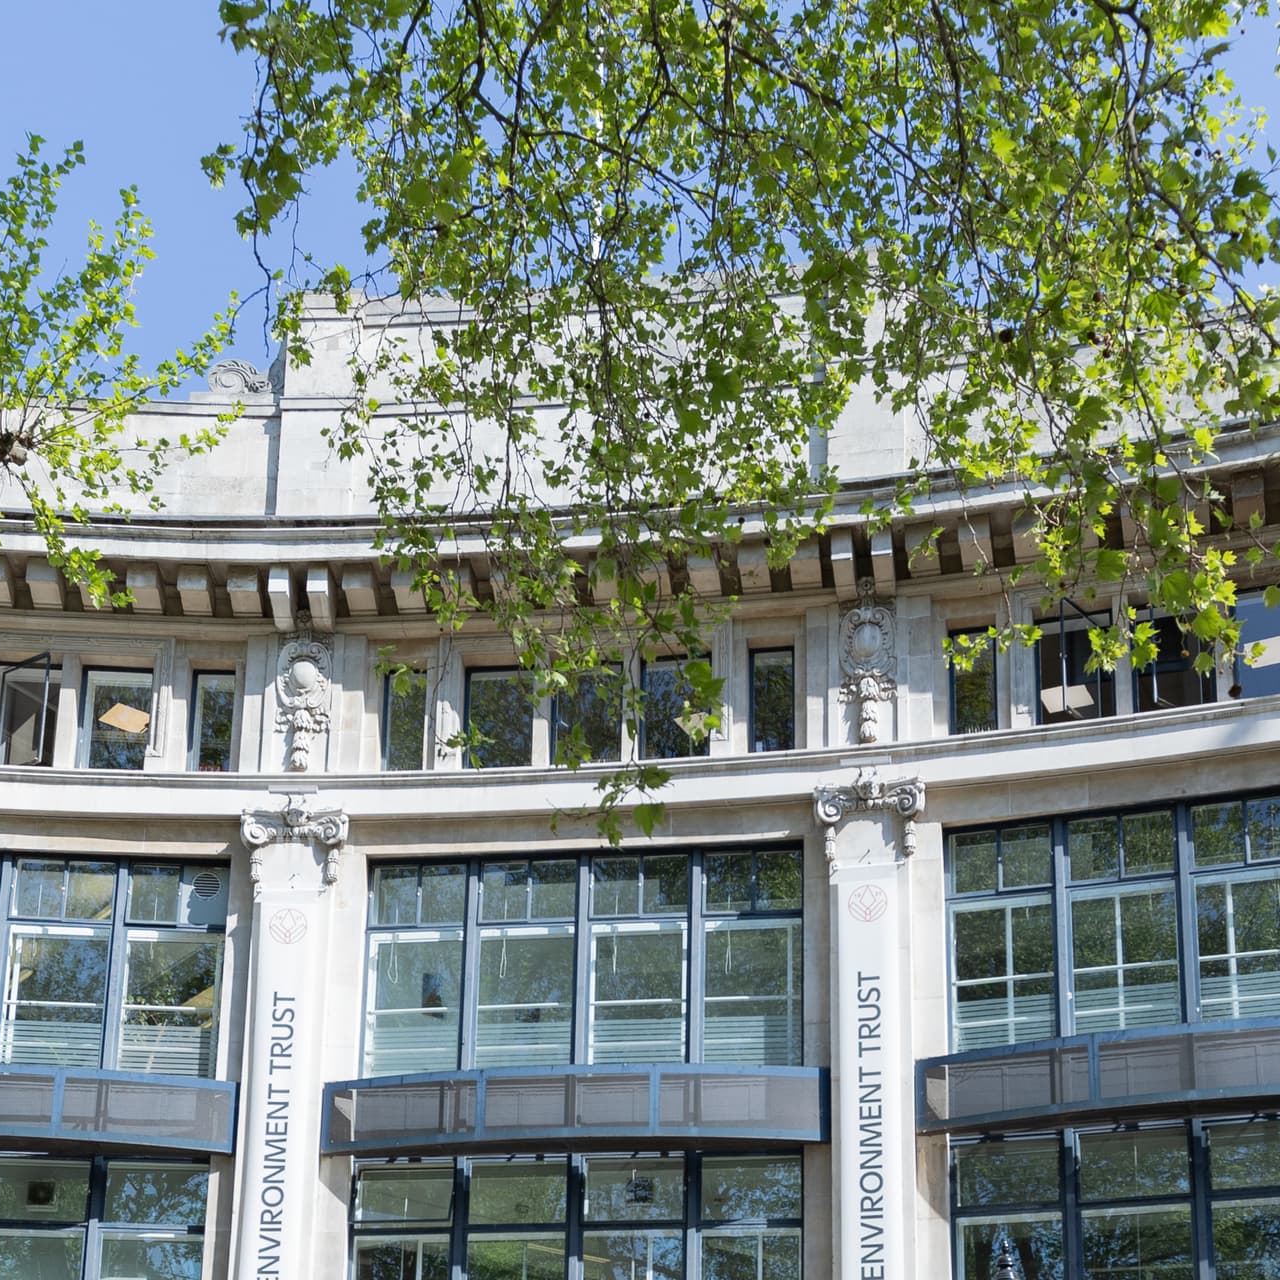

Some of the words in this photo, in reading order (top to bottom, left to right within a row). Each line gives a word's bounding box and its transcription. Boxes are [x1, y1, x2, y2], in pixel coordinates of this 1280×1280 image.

[268, 991, 296, 1075] TRUST
[858, 970, 881, 1058] TRUST
[859, 1067, 884, 1280] ENVIRONMENT
